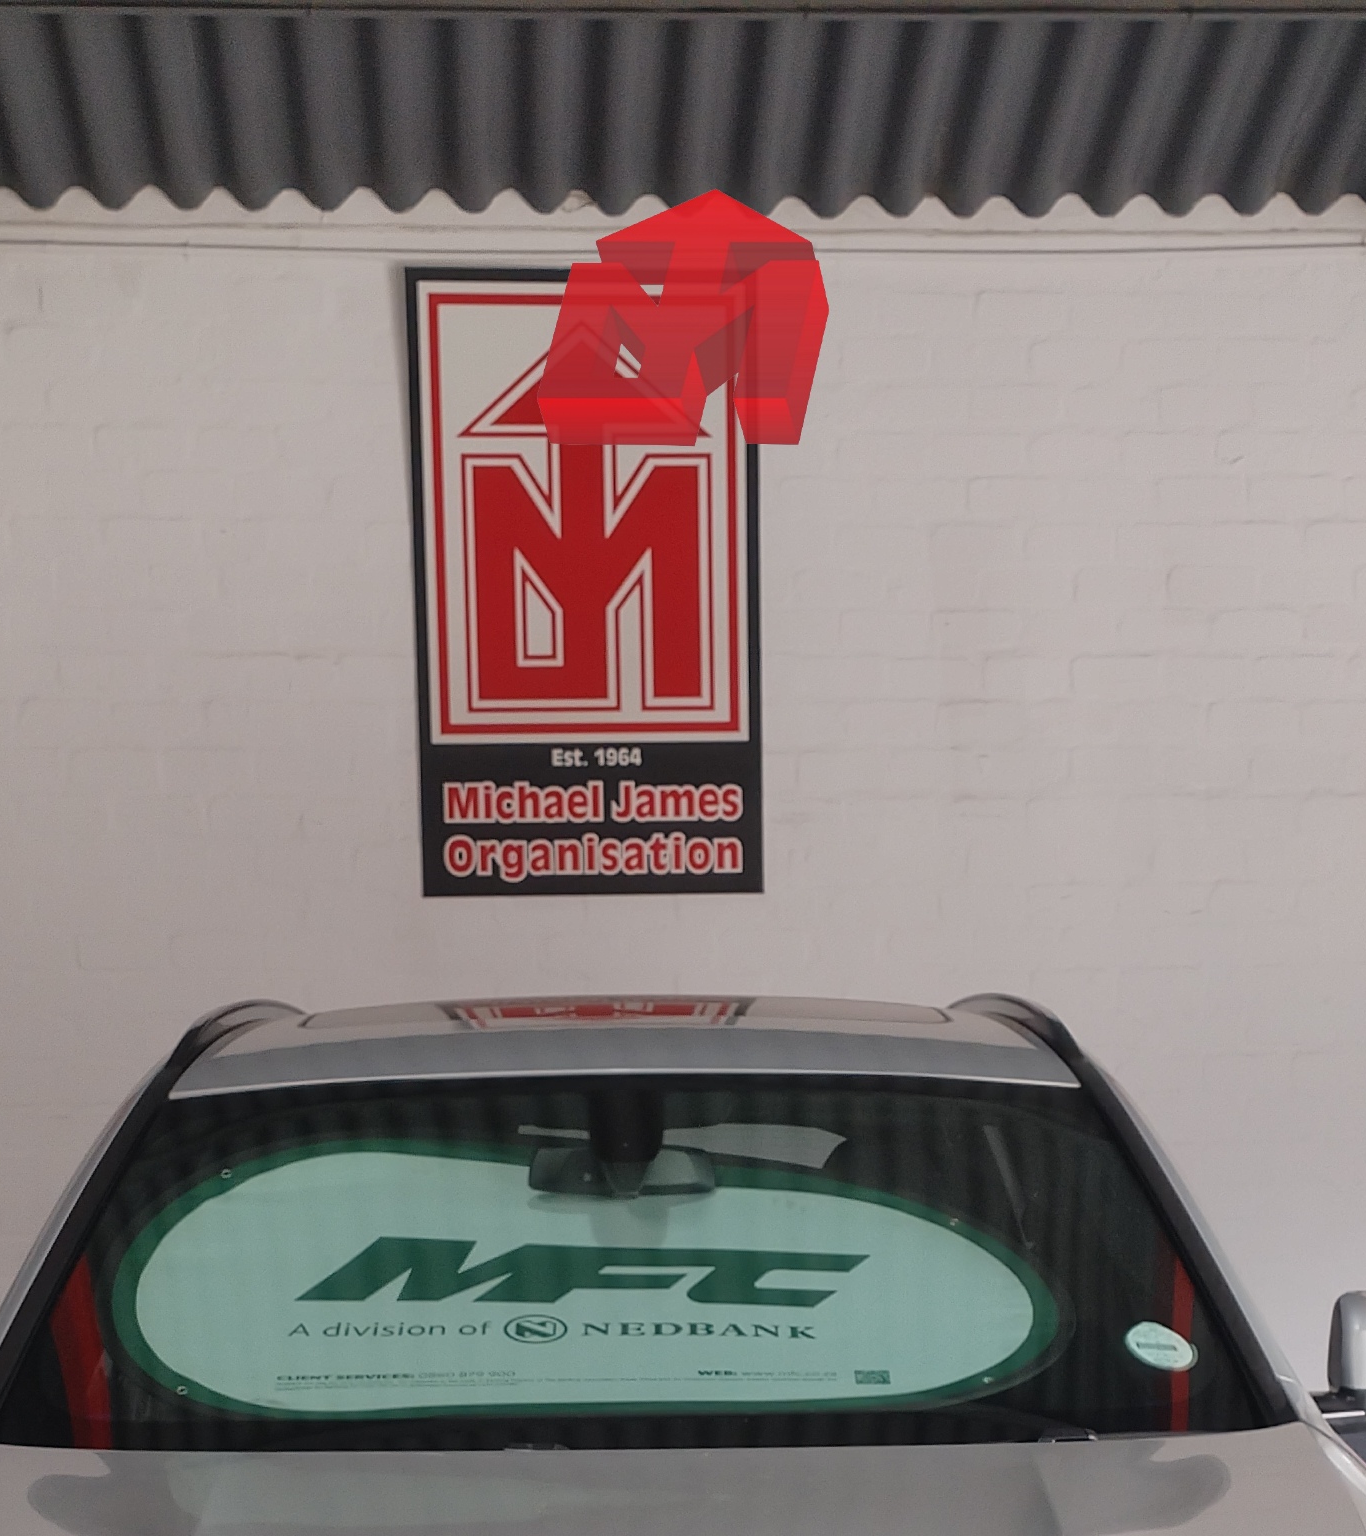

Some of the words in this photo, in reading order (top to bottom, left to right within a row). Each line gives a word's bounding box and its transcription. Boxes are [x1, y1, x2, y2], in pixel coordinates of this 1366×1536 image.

[551, 748, 589, 768] Est.
[593, 747, 643, 767] 1964
[444, 781, 603, 823] Michael
[611, 779, 742, 822] James
[444, 832, 742, 881] Organisation
[294, 1236, 871, 1307] MFC
[288, 1323, 310, 1337] A
[322, 1321, 446, 1338] division
[458, 1320, 492, 1336] of
[582, 1321, 817, 1340] NEDBANK
